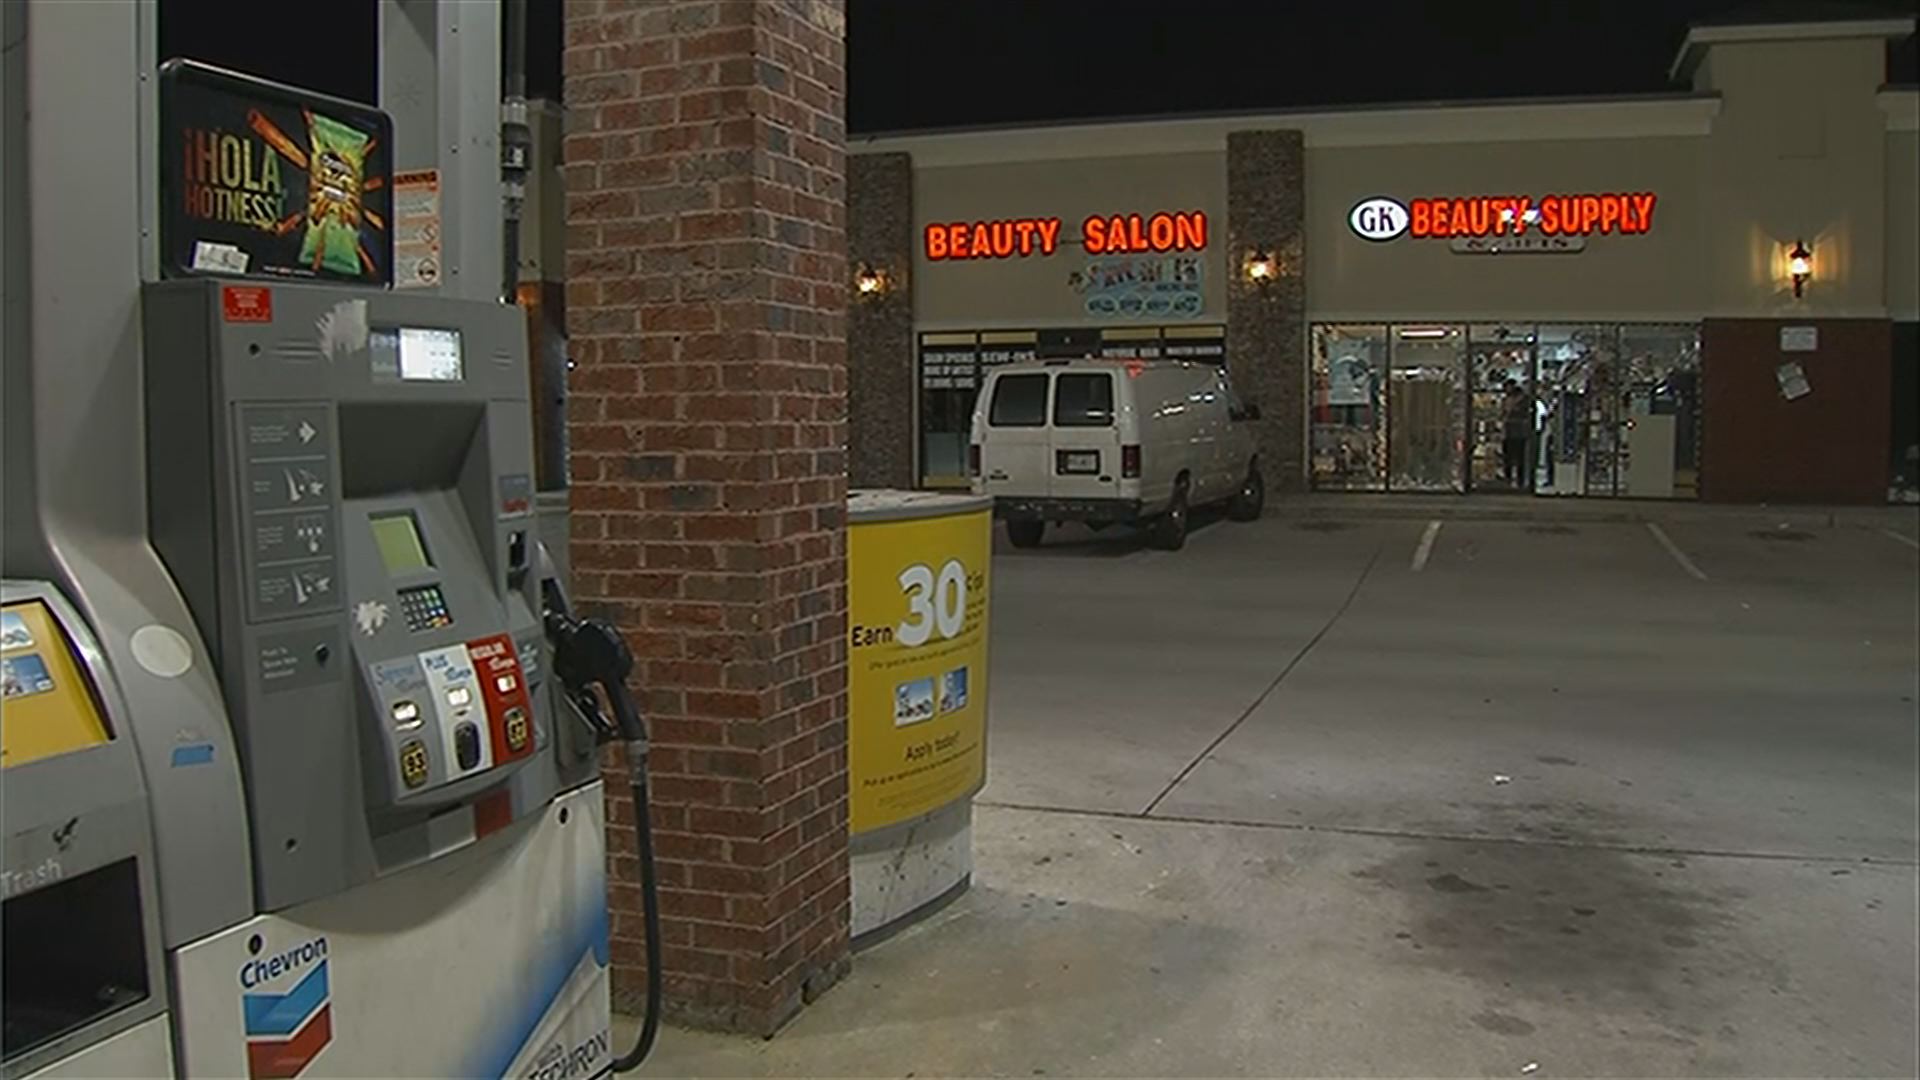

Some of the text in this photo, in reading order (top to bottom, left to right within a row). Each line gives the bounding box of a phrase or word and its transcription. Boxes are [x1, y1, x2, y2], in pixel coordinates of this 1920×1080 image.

[925, 211, 1207, 260] BEAUTY SALON
[1357, 192, 1656, 237] GK BEAUTY SUPPLY
[851, 625, 894, 647] Earn
[897, 559, 966, 647] 30
[0, 858, 62, 898] Trash
[240, 936, 328, 989] Chevron
